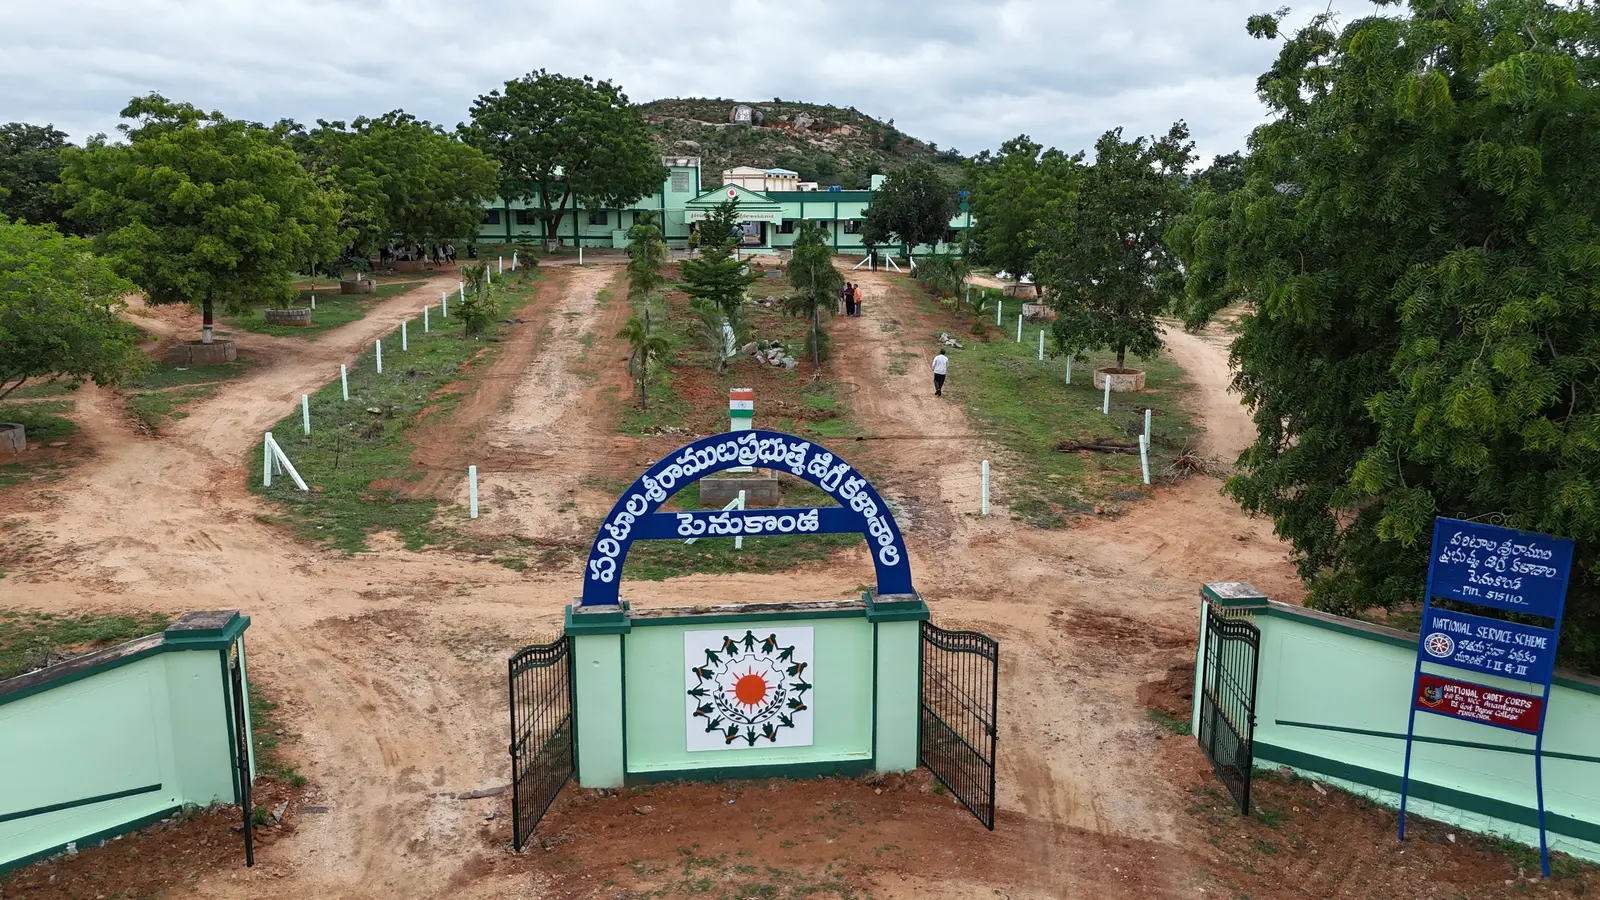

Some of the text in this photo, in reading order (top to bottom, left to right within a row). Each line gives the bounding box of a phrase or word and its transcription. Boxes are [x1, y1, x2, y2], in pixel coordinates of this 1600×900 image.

[676, 509, 819, 536] పెనుకొండ
[1450, 531, 1497, 551] పరిటాల
[1467, 569, 1522, 590] పెనుకొండ
[1432, 616, 1548, 650] NATIONAL SERVICE SCHEME
[1514, 664, 1529, 675] III
[1443, 684, 1533, 709] NATIONAL CADET CORPS
[1483, 701, 1526, 714] Anantapur
[1494, 709, 1519, 721] College
